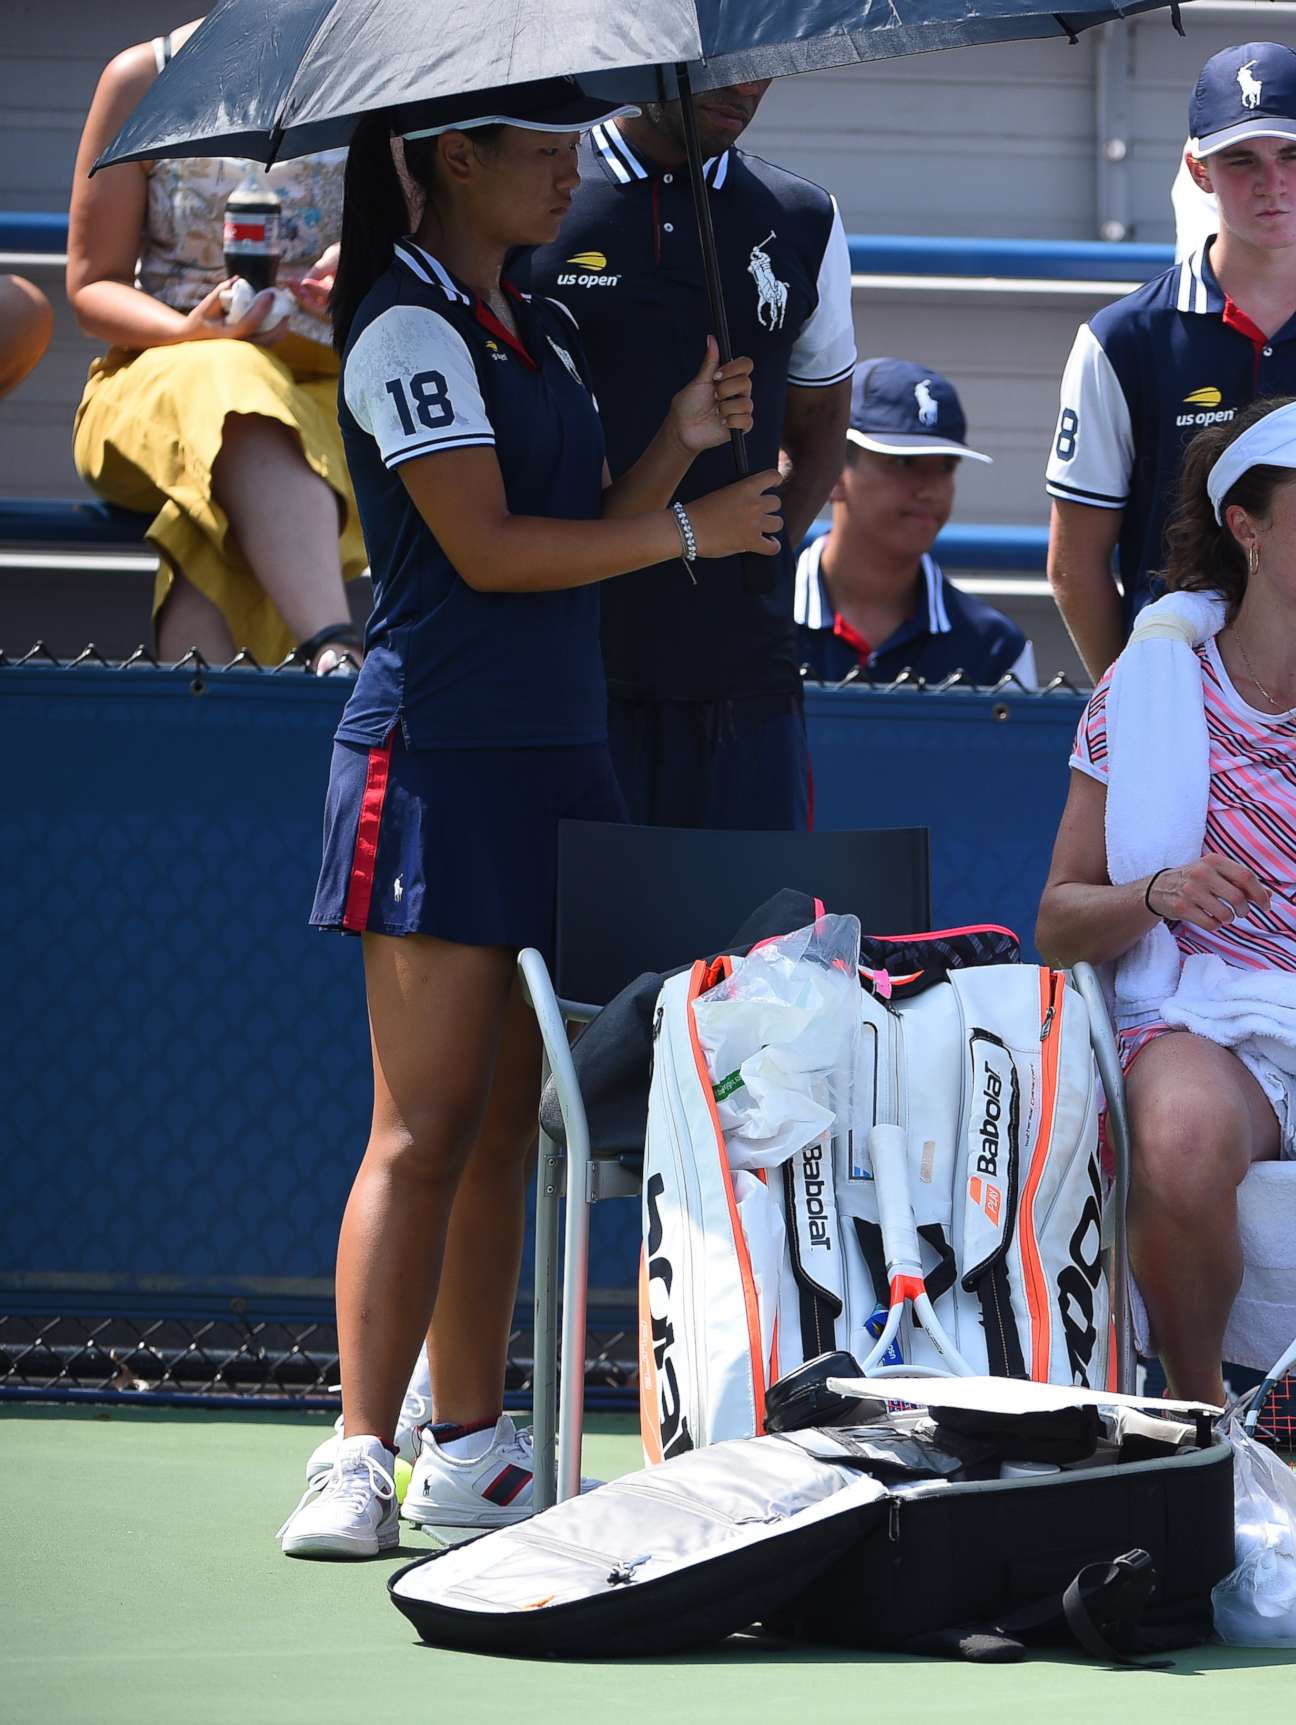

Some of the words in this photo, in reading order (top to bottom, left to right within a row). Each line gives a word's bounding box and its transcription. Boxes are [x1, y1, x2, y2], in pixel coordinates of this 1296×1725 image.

[557, 274, 577, 285] us
[578, 274, 618, 288] open
[385, 370, 455, 436] 18
[1176, 412, 1194, 426] us
[1196, 409, 1234, 427] open
[977, 1061, 1003, 1177] Babolat
[803, 1144, 831, 1251] Babolat
